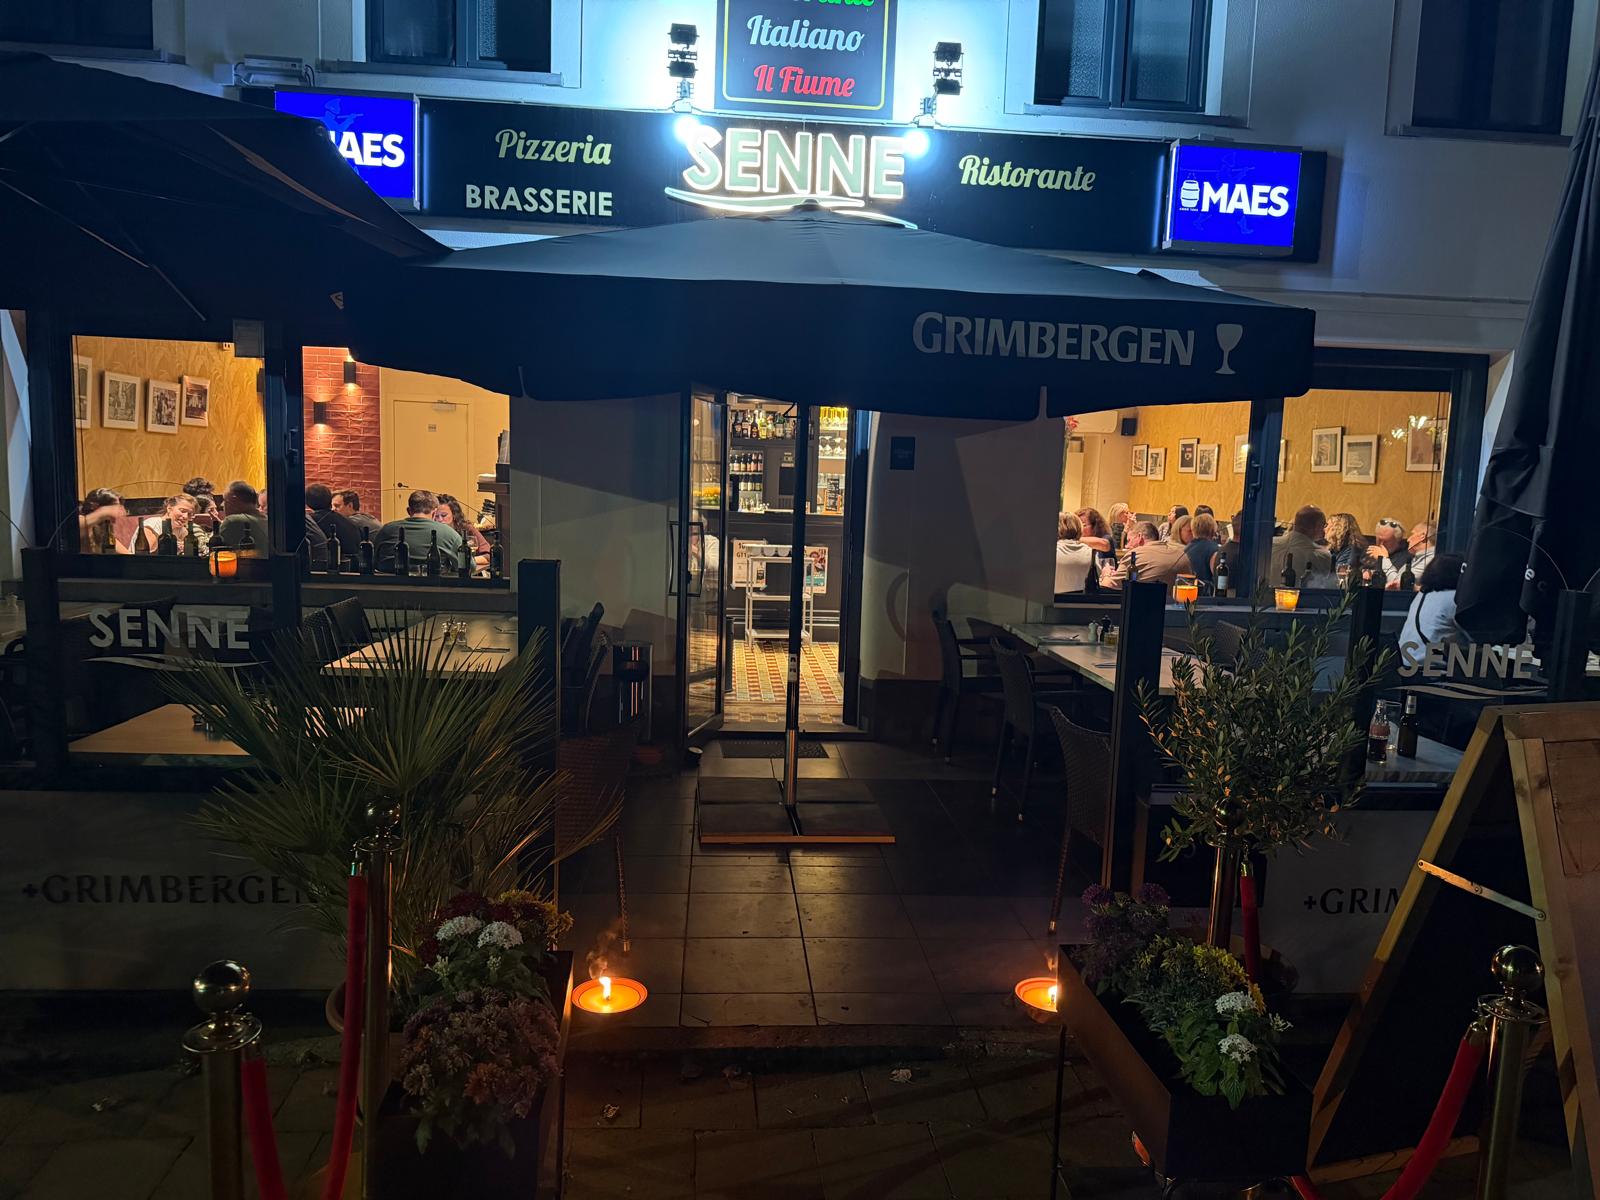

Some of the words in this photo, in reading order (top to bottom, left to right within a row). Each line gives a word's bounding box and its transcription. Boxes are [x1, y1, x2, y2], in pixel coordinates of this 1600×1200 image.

[746, 14, 865, 52] Italiano
[753, 64, 774, 92] Il
[778, 66, 856, 97] Fiume
[328, 130, 406, 168] AES
[495, 129, 612, 165] Pizzeria
[682, 124, 906, 200] SENNE
[958, 154, 1096, 192] Ristorante
[465, 184, 613, 217] BRASSERIE
[1199, 181, 1290, 217] MAES
[912, 311, 1196, 367] GRIMBERGEN
[88, 607, 251, 650] SENNE
[1396, 641, 1536, 679] SENNE
